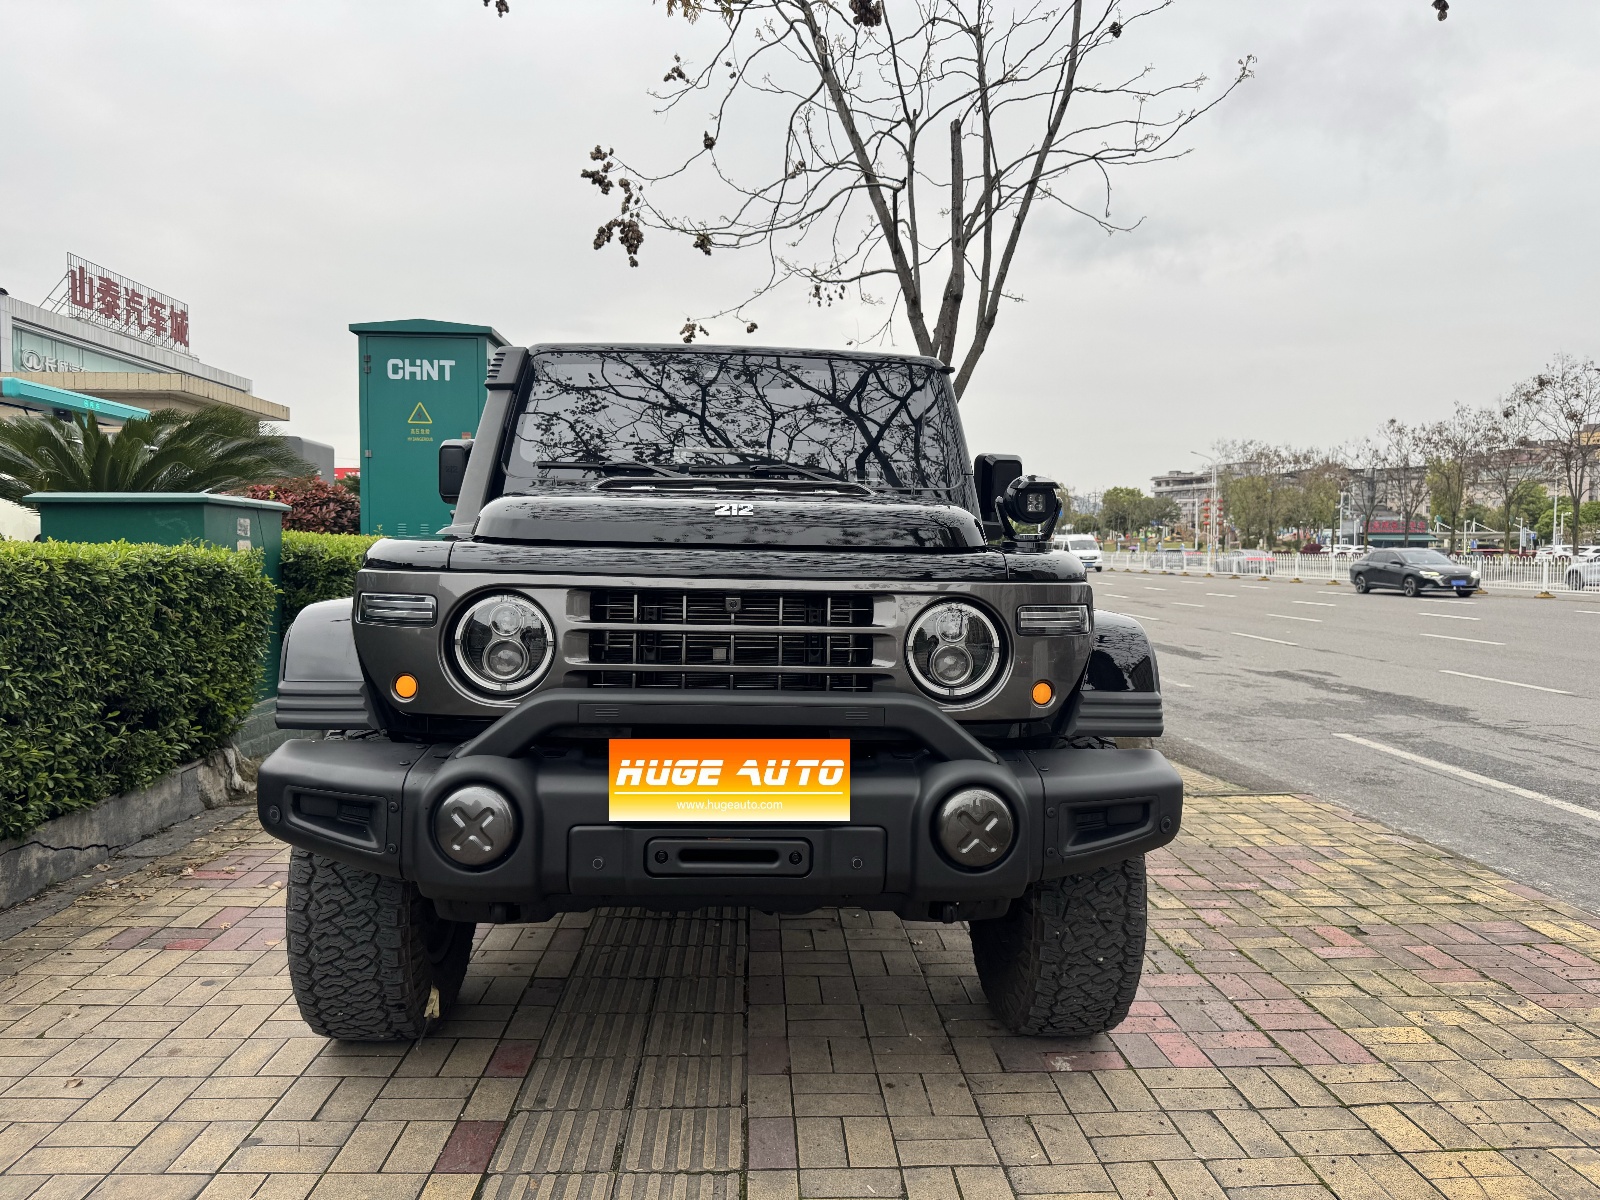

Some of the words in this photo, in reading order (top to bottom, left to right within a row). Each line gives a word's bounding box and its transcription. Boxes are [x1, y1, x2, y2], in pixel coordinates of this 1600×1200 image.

[70, 265, 189, 347] 山泰汽车城
[714, 503, 754, 517] 212
